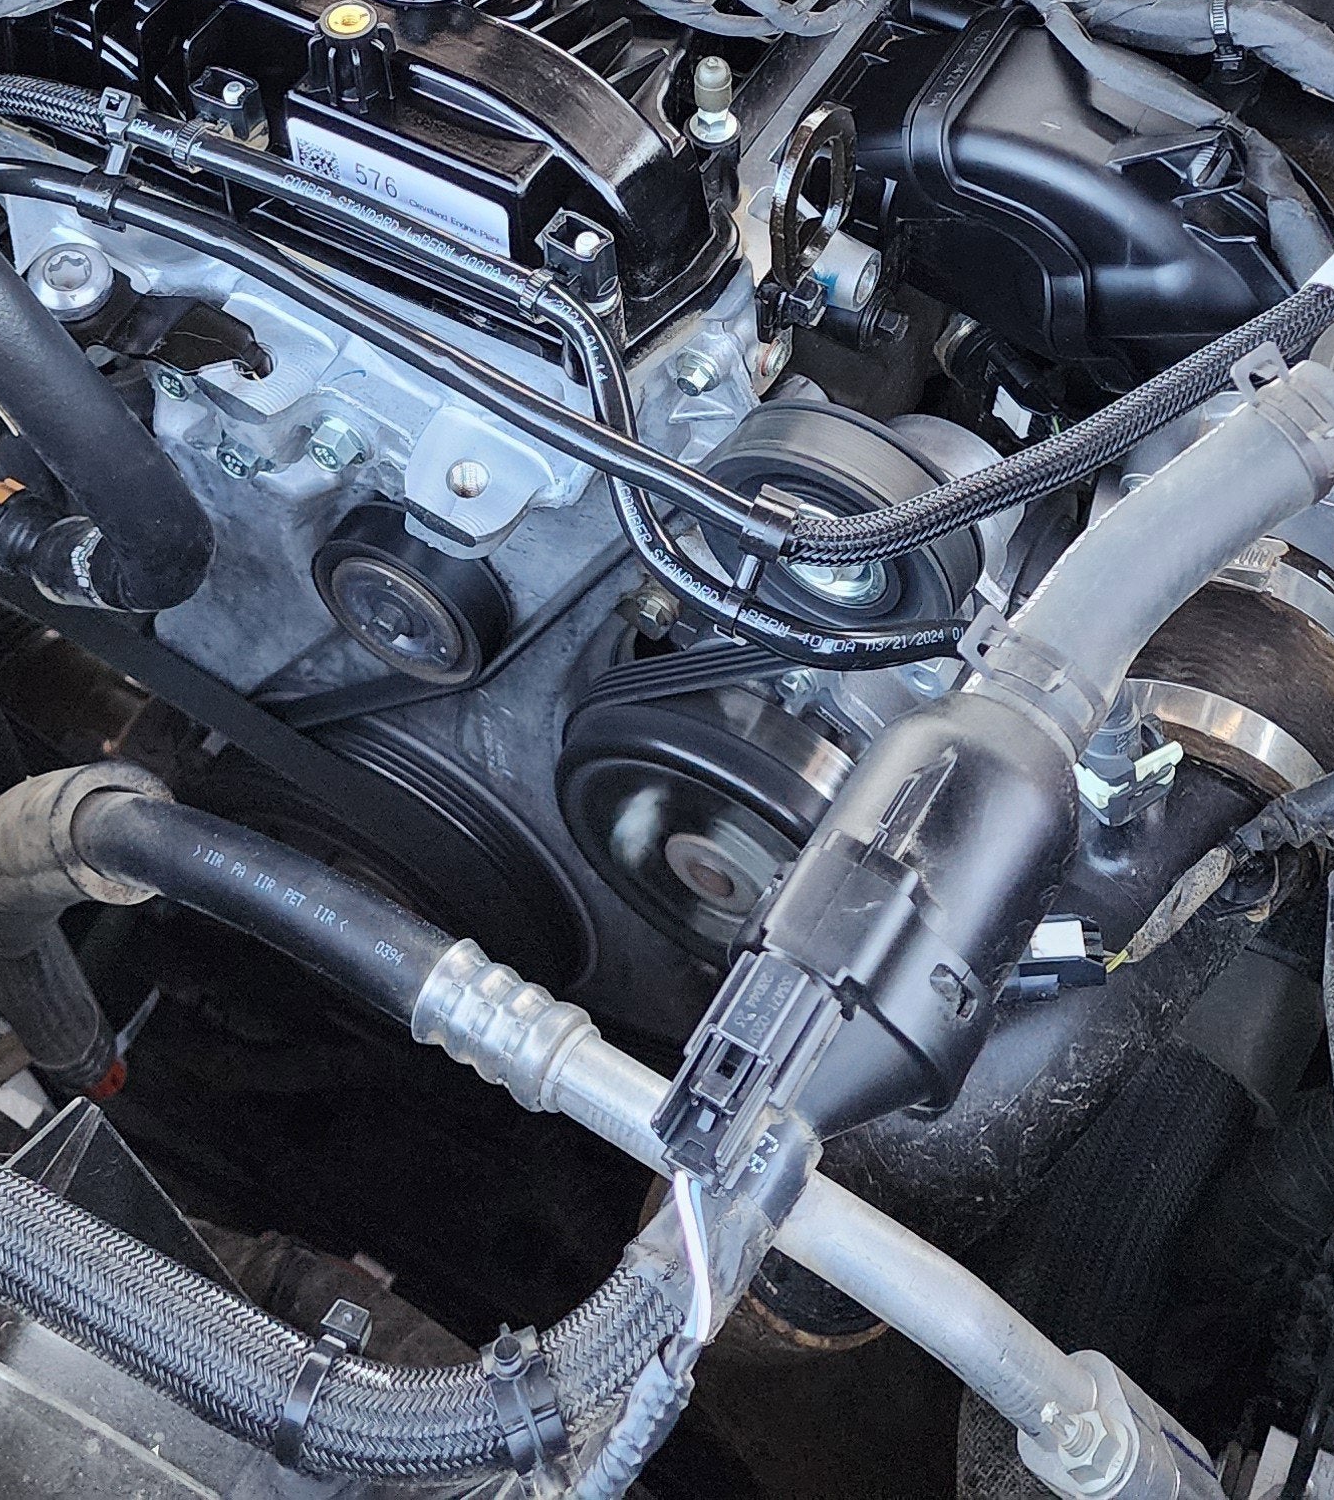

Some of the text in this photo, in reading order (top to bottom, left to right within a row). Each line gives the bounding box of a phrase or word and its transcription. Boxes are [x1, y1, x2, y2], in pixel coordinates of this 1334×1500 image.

[283, 173, 334, 202] COOPER
[337, 195, 401, 236] STANDARD
[354, 162, 400, 200] 576
[408, 197, 448, 222] Cleveland
[449, 216, 478, 236] Engine
[651, 547, 721, 601] STANDARD
[229, 860, 248, 880] PA
[281, 886, 308, 909] PET
[373, 939, 407, 968] 0394
